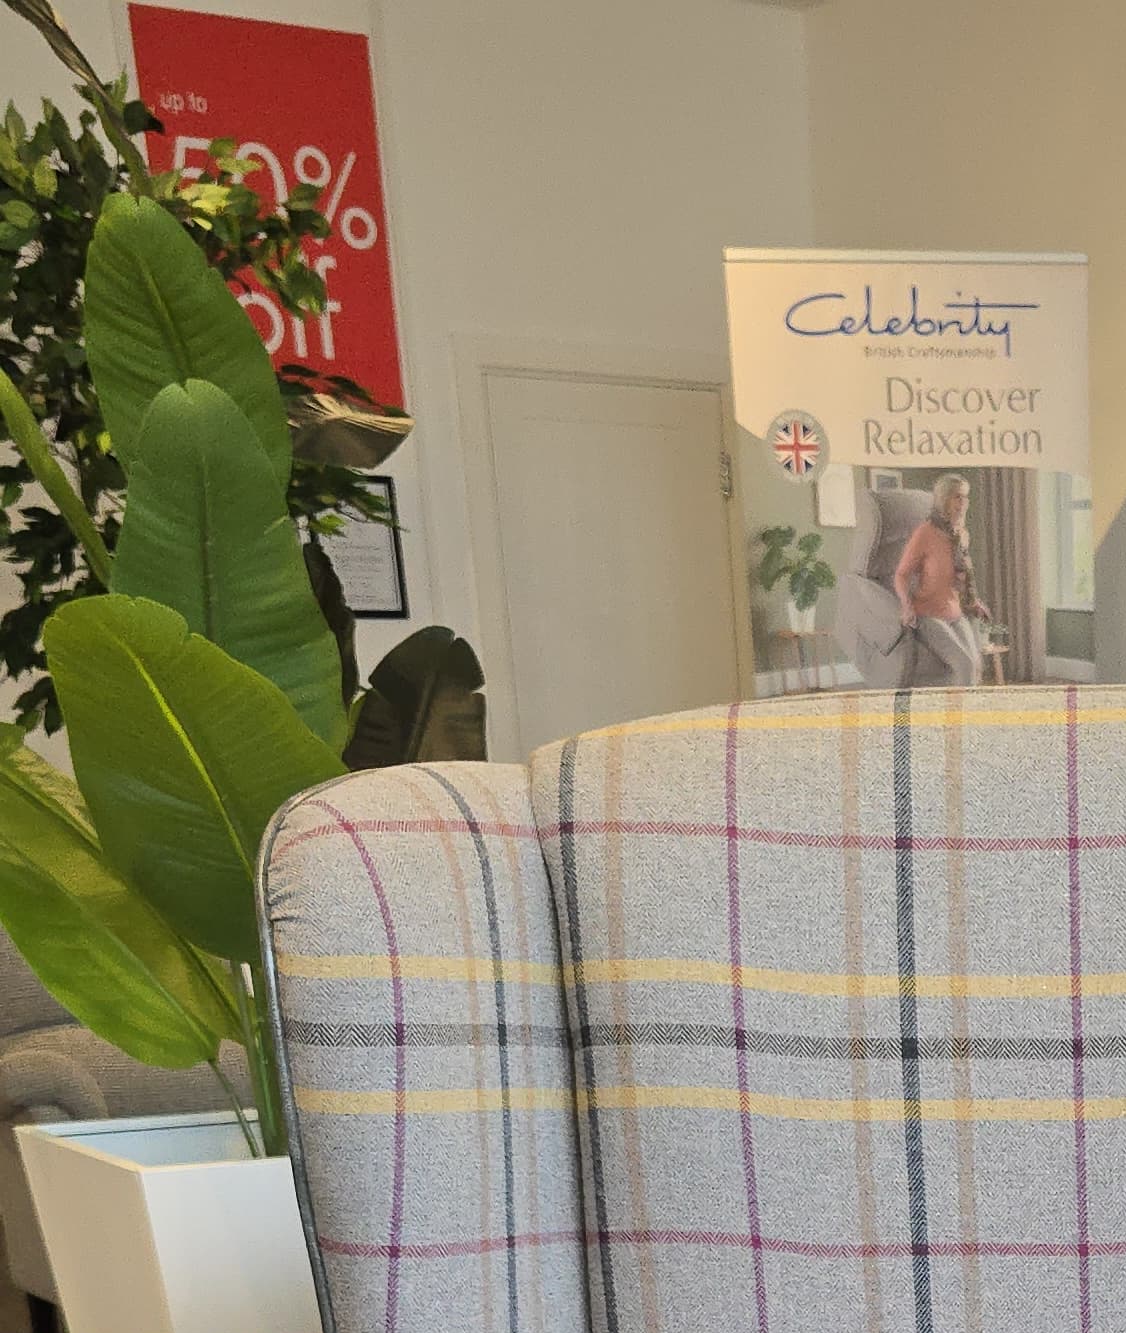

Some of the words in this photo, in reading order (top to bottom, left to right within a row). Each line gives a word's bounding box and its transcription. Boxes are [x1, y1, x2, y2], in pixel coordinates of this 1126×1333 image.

[160, 92, 184, 114] up
[188, 91, 208, 113] to
[785, 284, 1041, 358] Celebrity
[886, 375, 1041, 414] Discover
[863, 418, 1043, 455] Relaxation
